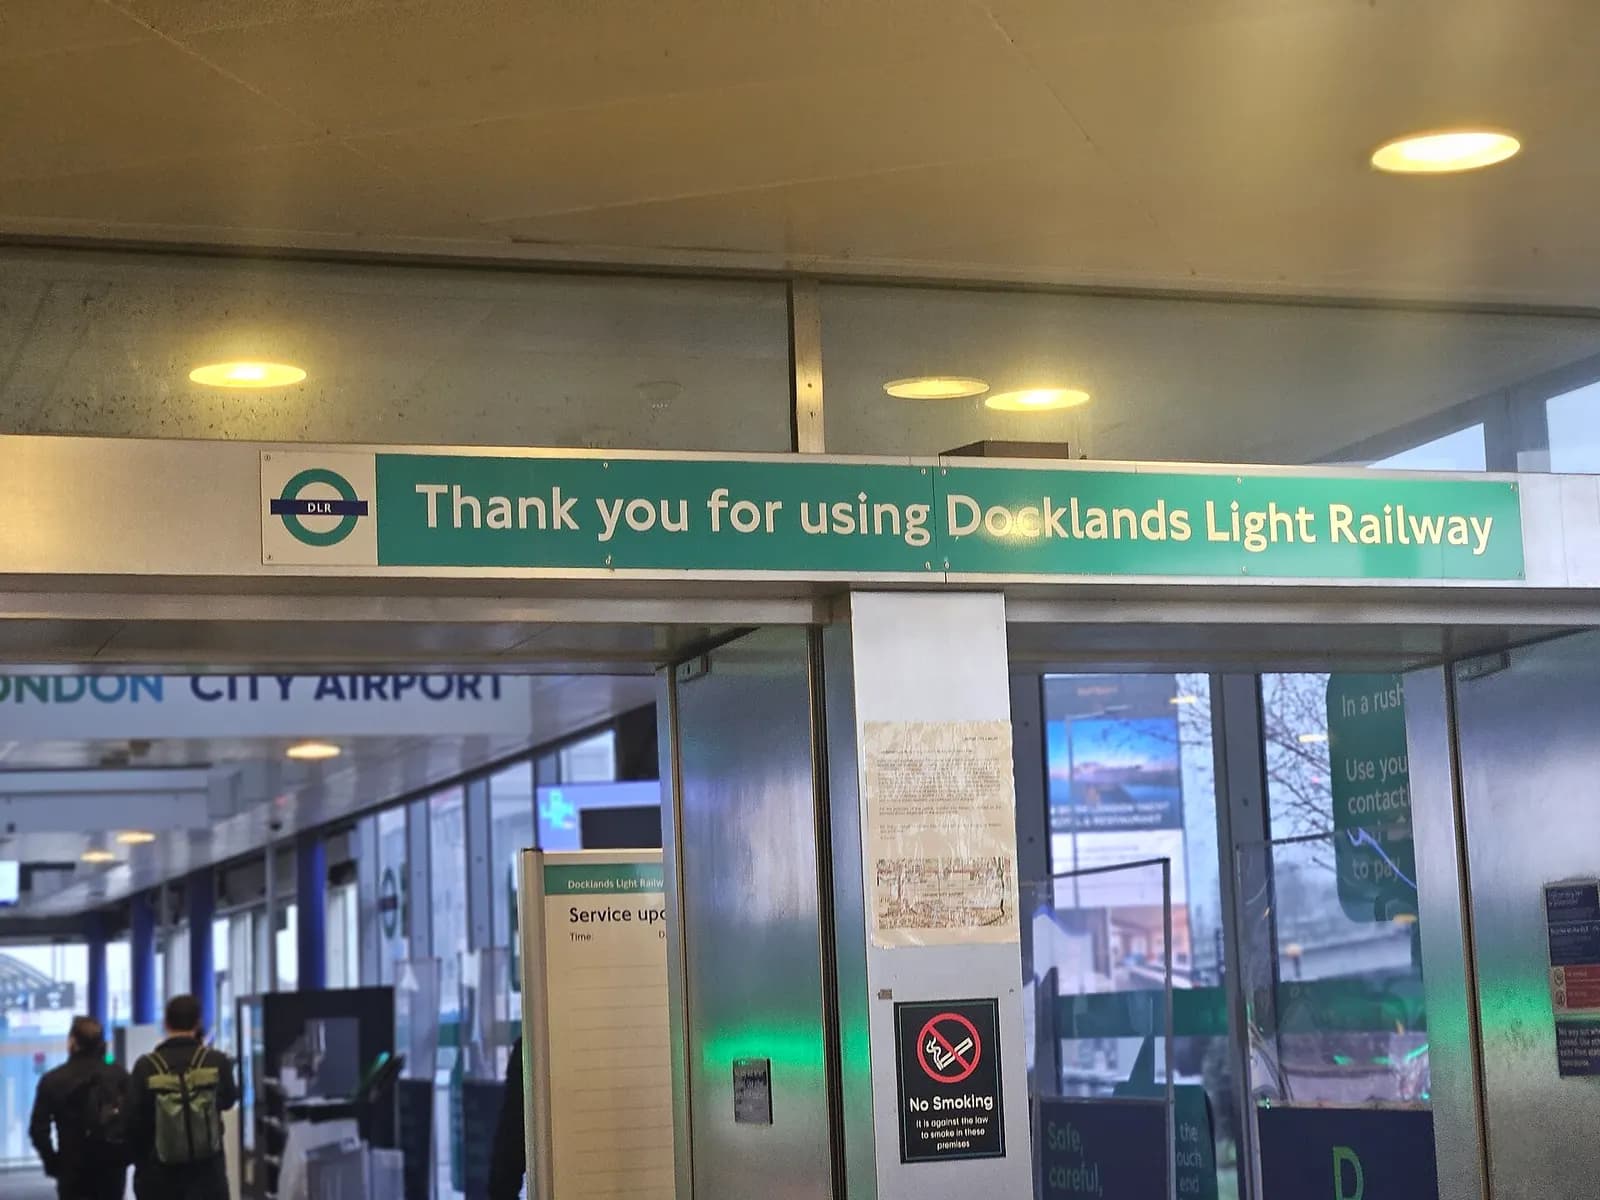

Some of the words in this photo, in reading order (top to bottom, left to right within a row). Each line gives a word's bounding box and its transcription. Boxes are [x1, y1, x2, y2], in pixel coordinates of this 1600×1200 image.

[307, 502, 332, 513] DLR
[415, 483, 580, 530] Thank
[595, 498, 689, 542] you
[706, 487, 783, 533] for
[800, 491, 931, 547] using
[947, 494, 1192, 541] Docklands
[1205, 500, 1317, 553] Light
[1328, 503, 1493, 556] Railway
[0, 674, 164, 704] NDON
[190, 675, 295, 702] CITY
[313, 674, 501, 702] AIRPORT
[1341, 694, 1356, 717] In
[1360, 695, 1369, 715] a
[1345, 759, 1375, 783] Use
[1352, 857, 1369, 880] to
[1374, 855, 1401, 883] pay
[567, 879, 614, 890] Docklands
[616, 879, 638, 890] Light
[569, 906, 632, 923] Service
[569, 931, 592, 942] Time
[909, 1097, 929, 1113] No
[933, 1093, 994, 1111] Smoking
[923, 1118, 930, 1128] is
[931, 1117, 960, 1129] against
[961, 1116, 974, 1126] the
[975, 1115, 989, 1125] law
[1179, 1122, 1199, 1142] the
[921, 1130, 929, 1140] to
[930, 1129, 955, 1139] smoke
[956, 1128, 964, 1138] in
[964, 1127, 986, 1137] these
[1047, 1120, 1084, 1157] Safe,
[937, 1140, 971, 1152] premises
[1176, 1147, 1202, 1168] ouch
[1048, 1160, 1104, 1198] careful,
